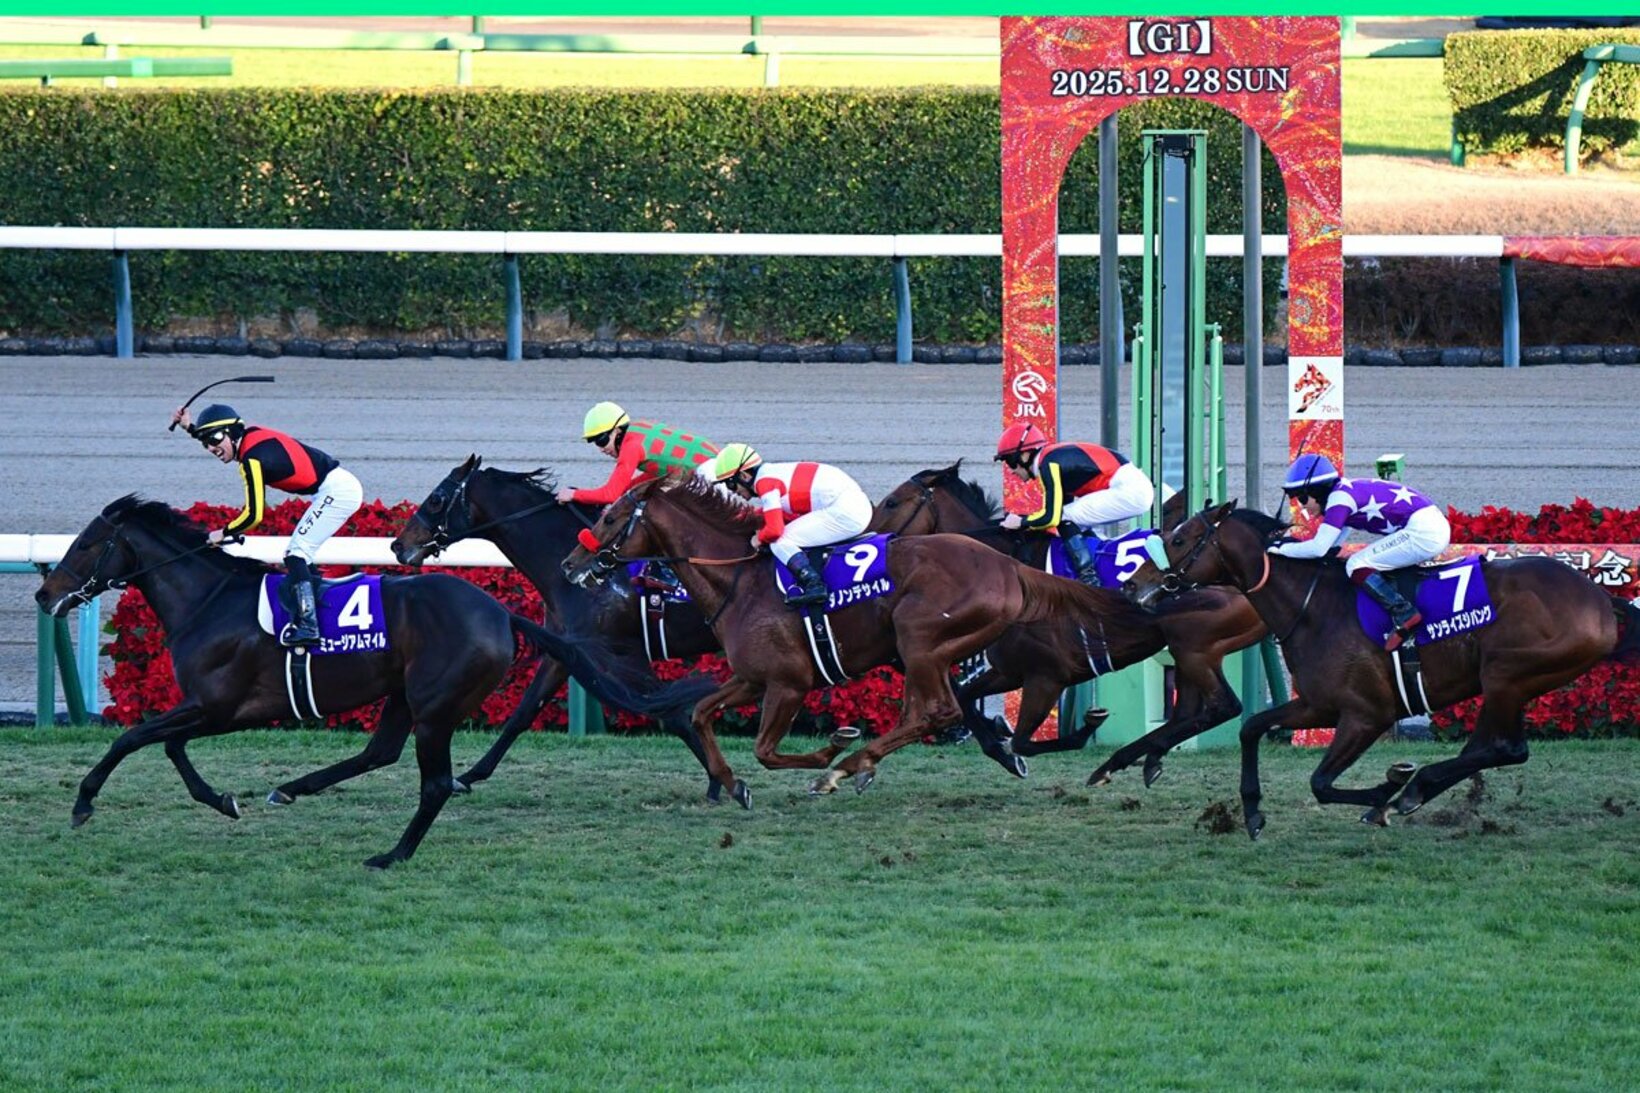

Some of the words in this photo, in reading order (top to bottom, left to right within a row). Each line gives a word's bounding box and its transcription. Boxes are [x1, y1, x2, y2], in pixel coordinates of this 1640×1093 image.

[1051, 69, 1222, 96] 2025.12.28
[1225, 67, 1291, 93] SUN
[1013, 403, 1047, 418] JRA
[844, 543, 879, 582] 9
[1115, 537, 1146, 582] 5
[337, 584, 374, 631] 4
[1438, 564, 1474, 613] 7
